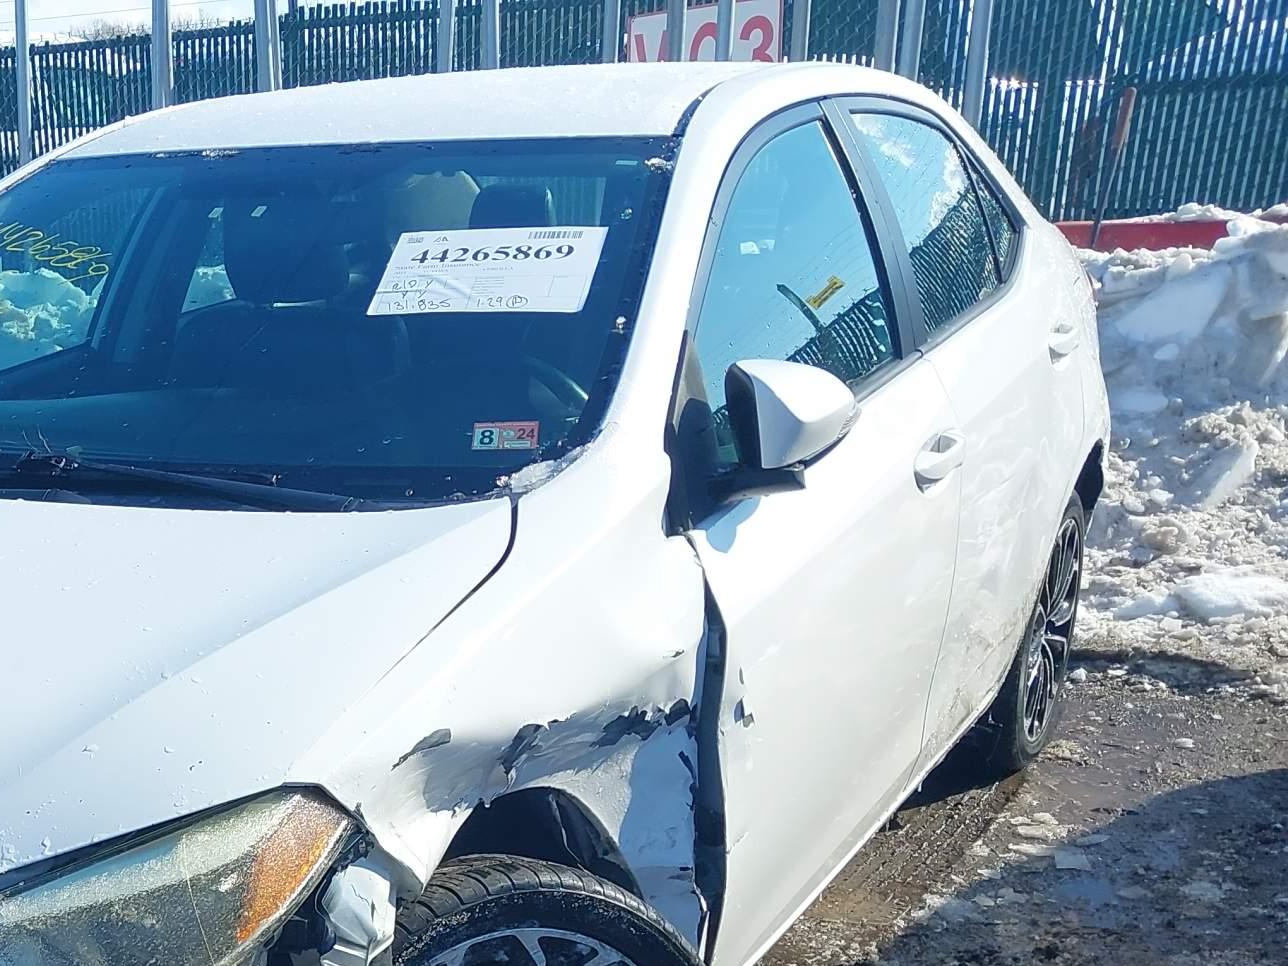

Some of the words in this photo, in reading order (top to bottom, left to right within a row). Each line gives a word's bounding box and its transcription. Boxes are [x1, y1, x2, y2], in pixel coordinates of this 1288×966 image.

[411, 244, 575, 264] 44265869
[479, 429, 495, 445] 8
[517, 428, 536, 440] 24
